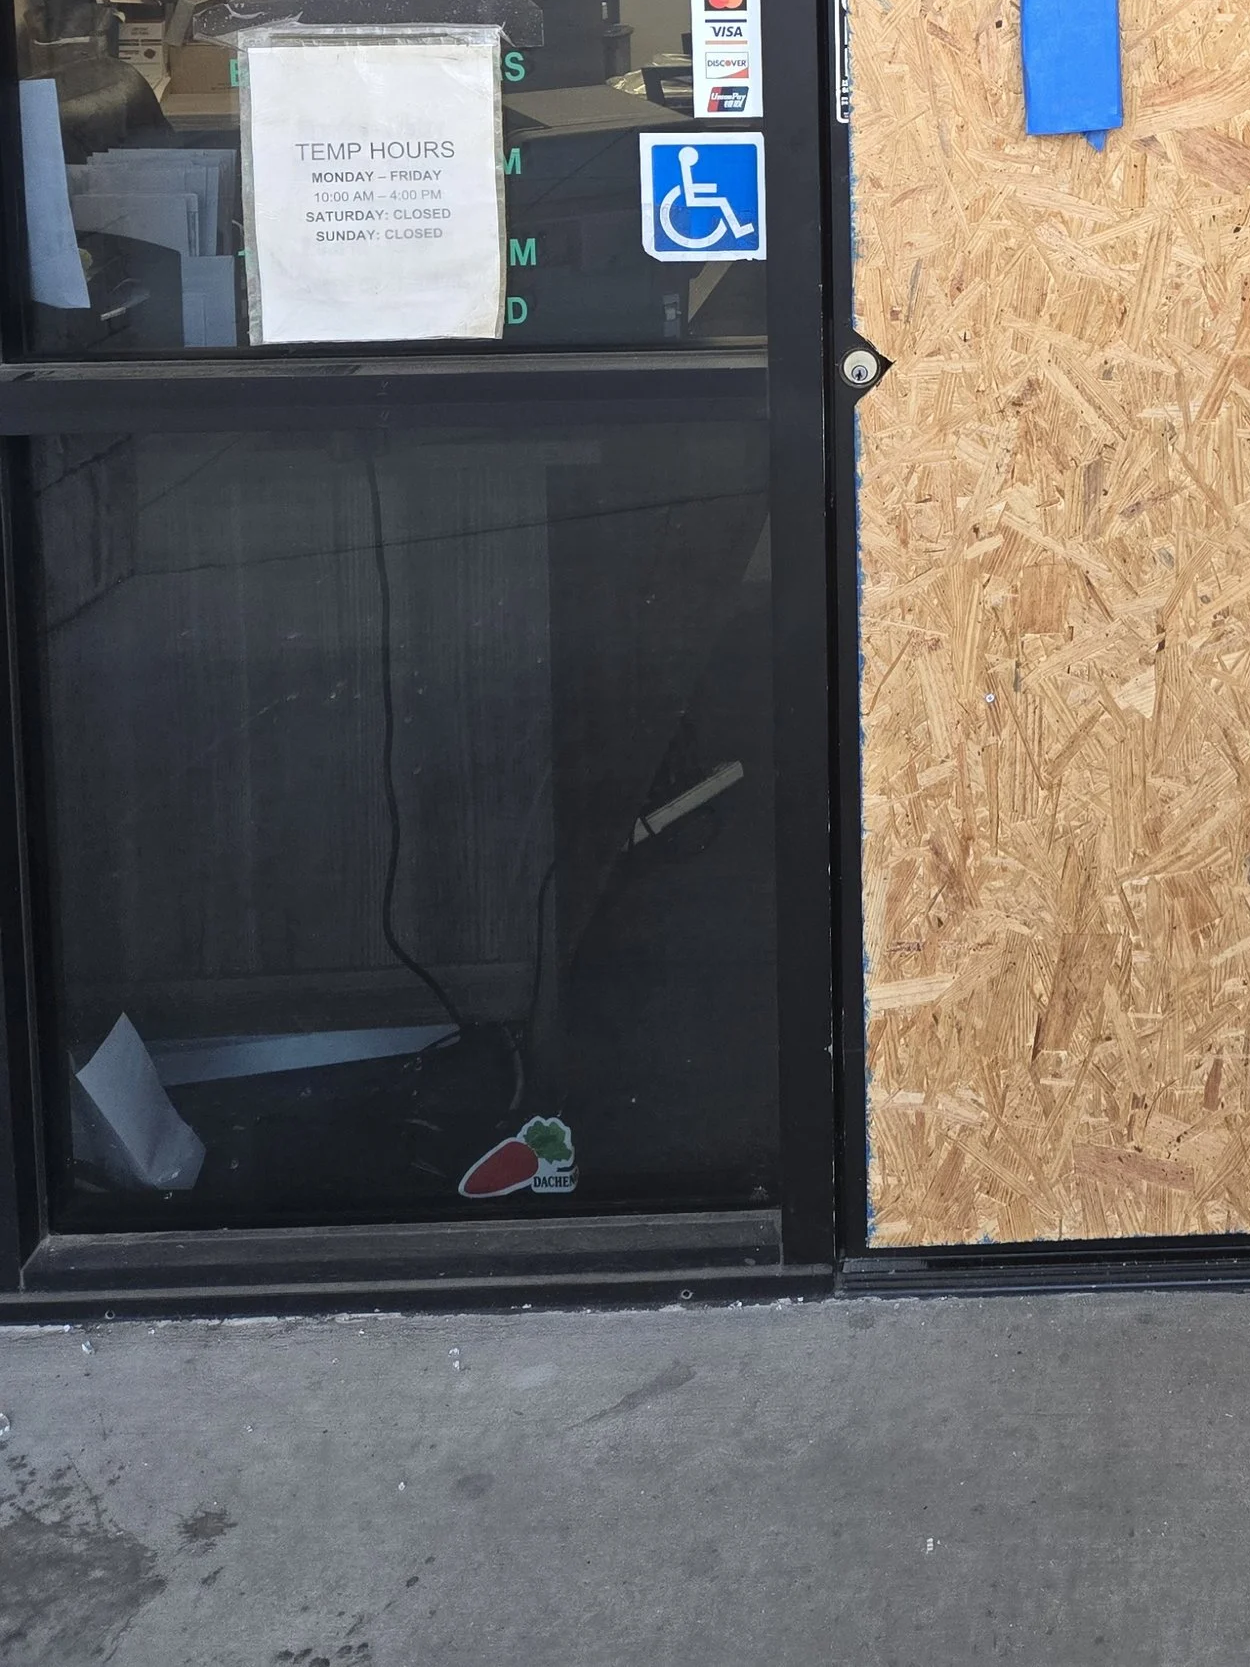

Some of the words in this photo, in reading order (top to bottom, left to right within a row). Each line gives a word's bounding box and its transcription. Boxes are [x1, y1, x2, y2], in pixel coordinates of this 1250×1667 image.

[711, 26, 743, 38] VISA
[707, 59, 747, 72] DISCOVER
[295, 141, 362, 162] TEMP
[370, 139, 456, 160] HOURS
[311, 170, 374, 184] MONDAY
[390, 169, 443, 183] FRIDAY
[314, 191, 350, 203] 10:00
[352, 190, 375, 203] AM
[390, 190, 418, 202] 4:00
[421, 189, 442, 201] PM
[305, 209, 391, 223] SATURDAY:
[393, 208, 452, 221] CLOSED
[315, 228, 382, 242] SUNDAY:
[384, 227, 442, 241] CLOSED
[533, 1174, 579, 1188] DACHEN
